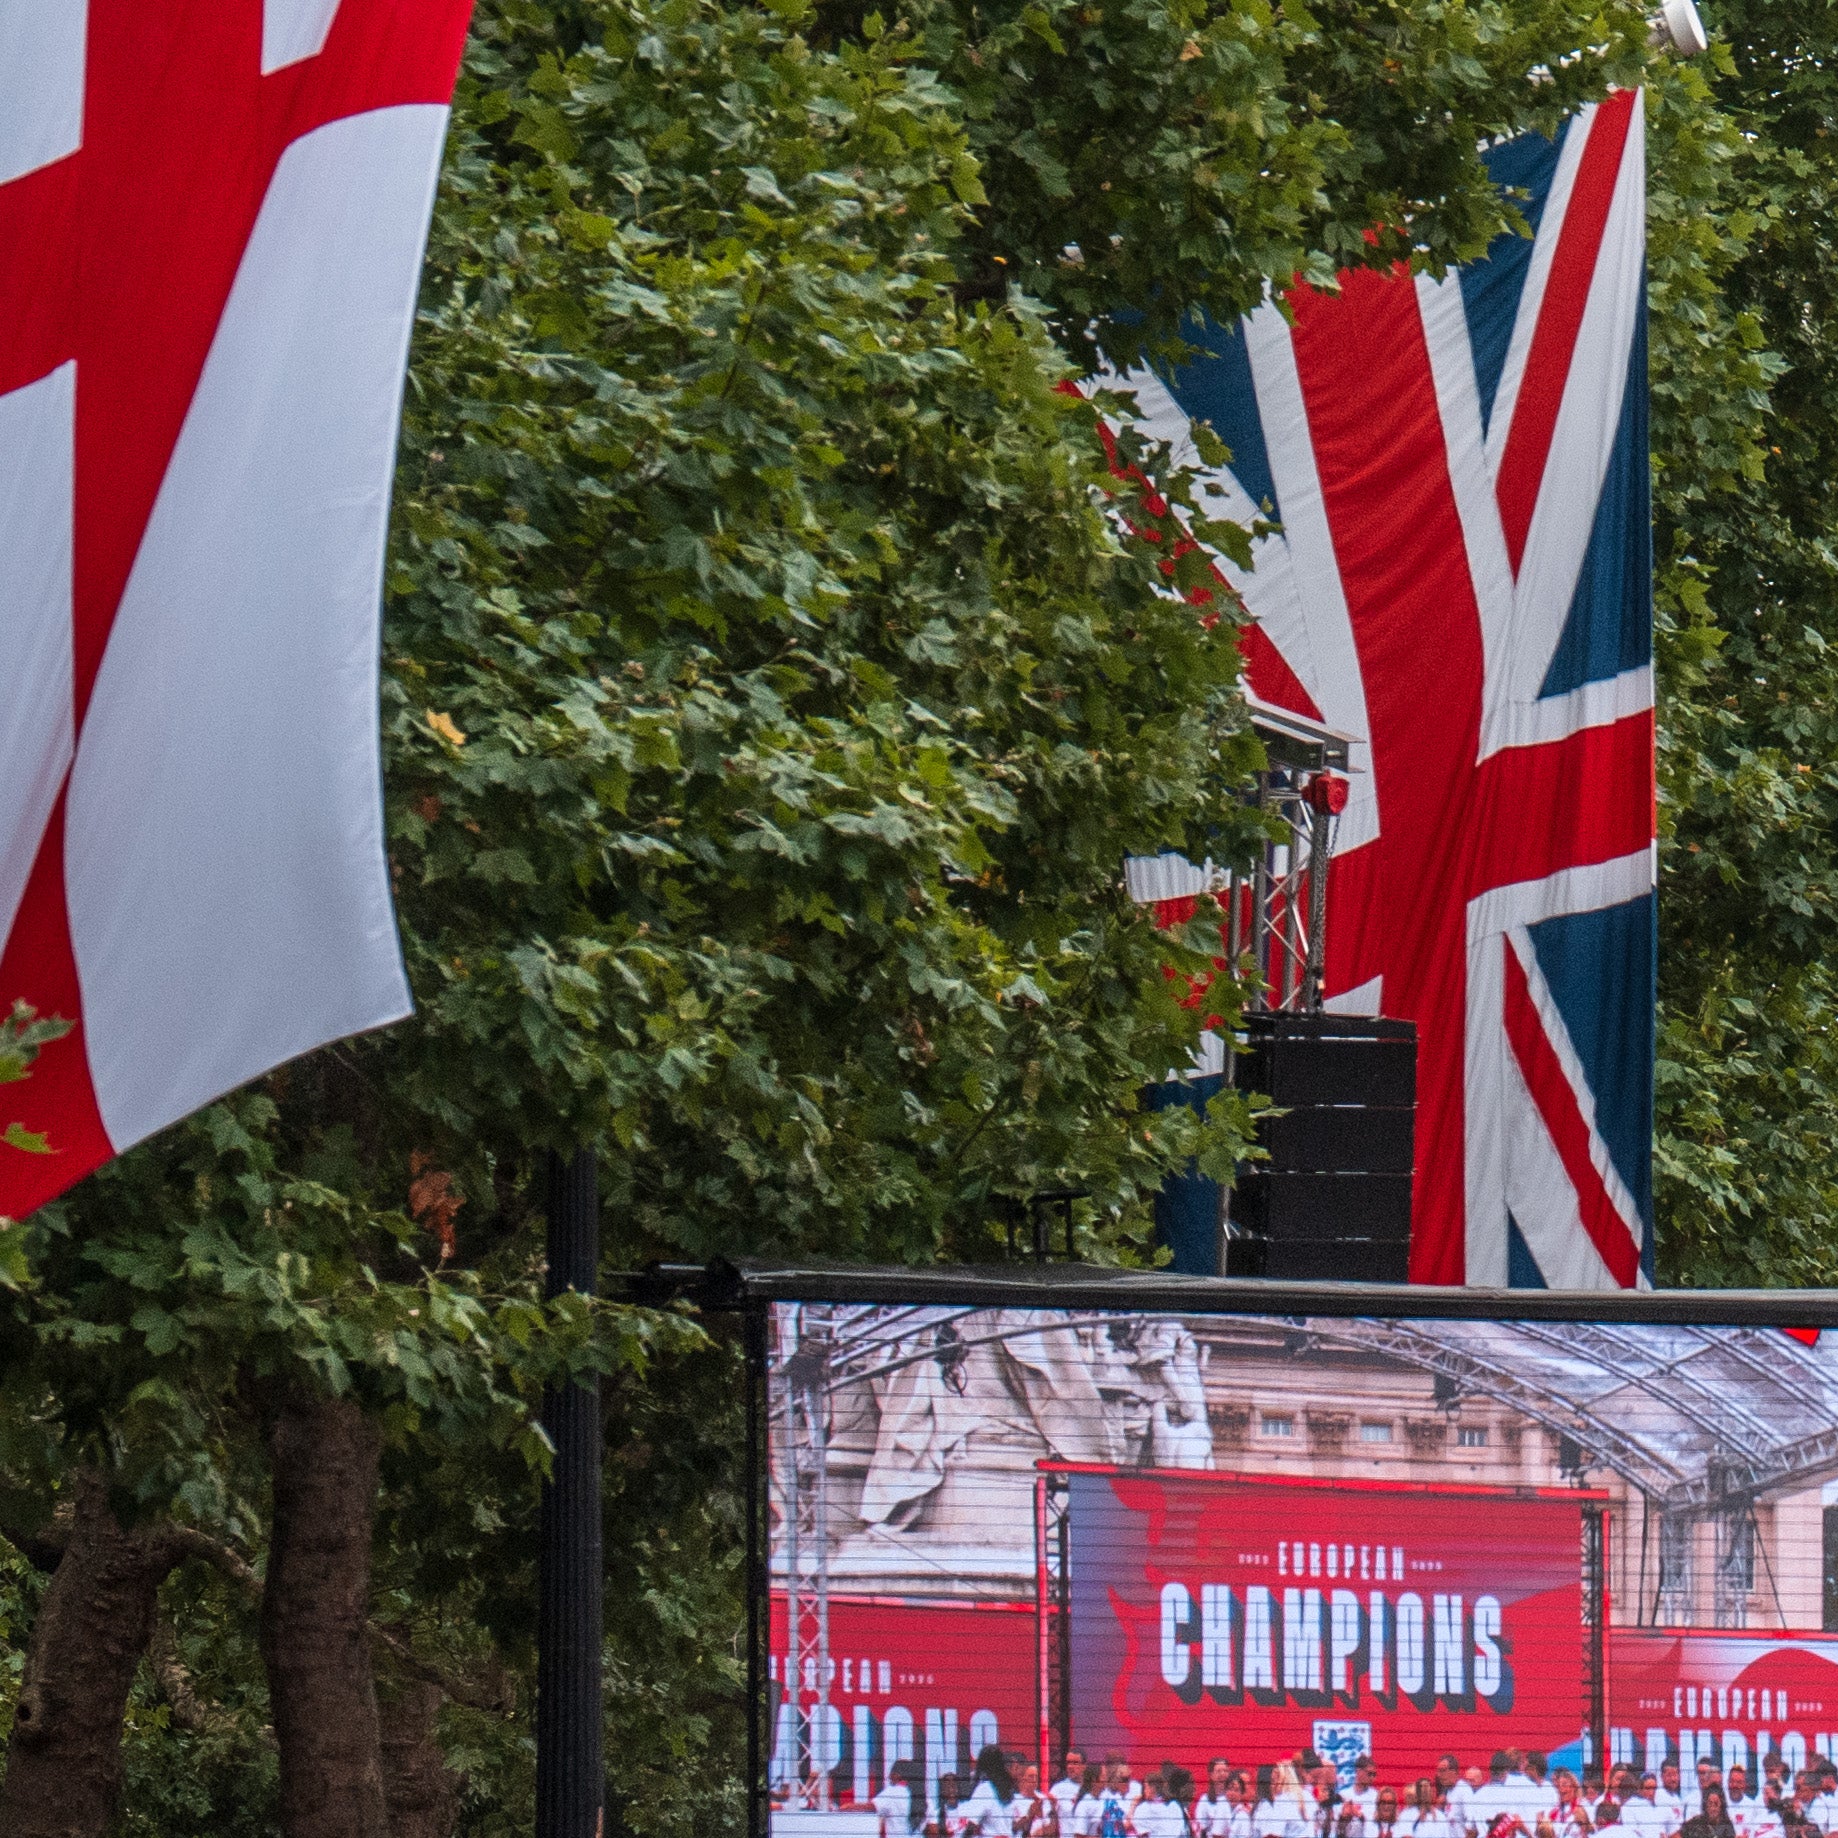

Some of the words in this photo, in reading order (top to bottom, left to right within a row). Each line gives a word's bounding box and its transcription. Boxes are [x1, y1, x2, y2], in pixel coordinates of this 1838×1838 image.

[1277, 1540, 1404, 1580] EUROPEAN
[1160, 1582, 1504, 1698] CHAMPIONS
[1673, 1686, 1788, 1721] EUROPEAN
